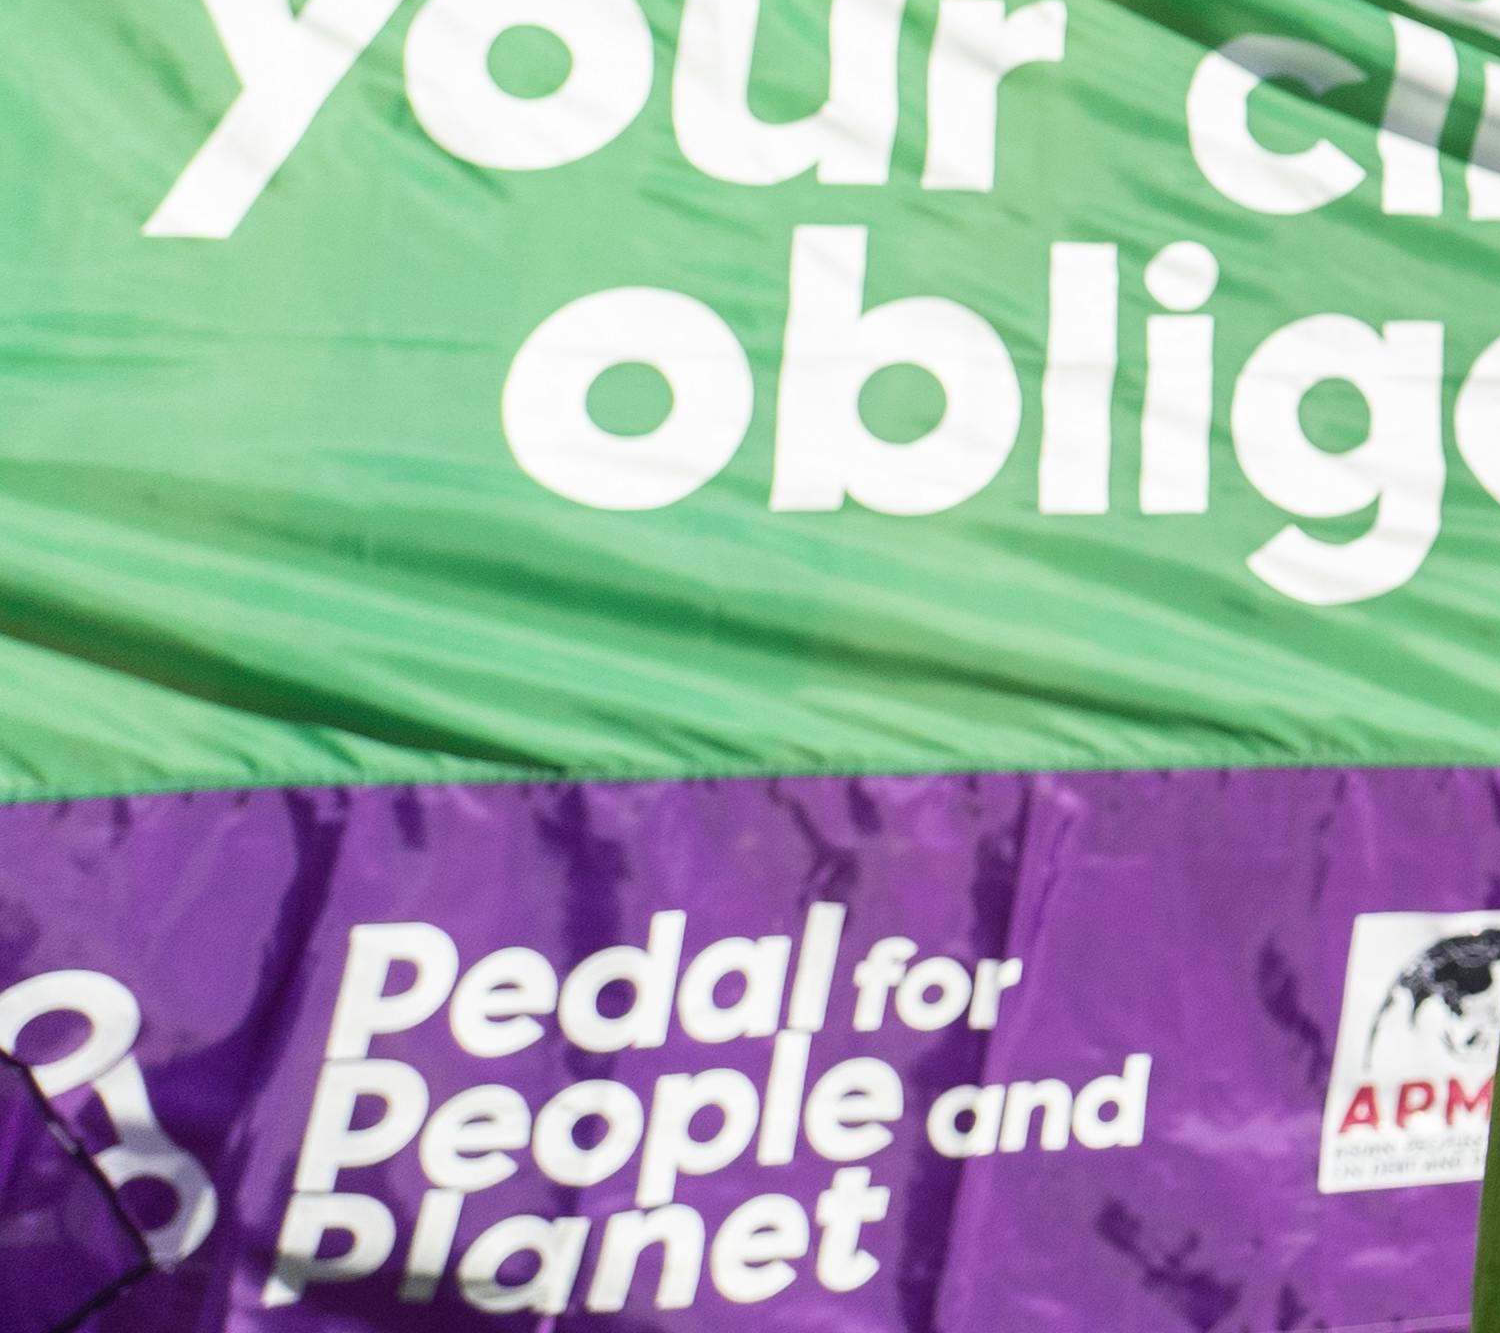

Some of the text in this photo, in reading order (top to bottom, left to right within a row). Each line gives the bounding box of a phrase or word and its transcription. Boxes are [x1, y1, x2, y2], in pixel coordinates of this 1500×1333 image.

[326, 901, 1023, 1061] Pedal for
[294, 1028, 1152, 1205] People and
[261, 1167, 891, 1316] Planet
